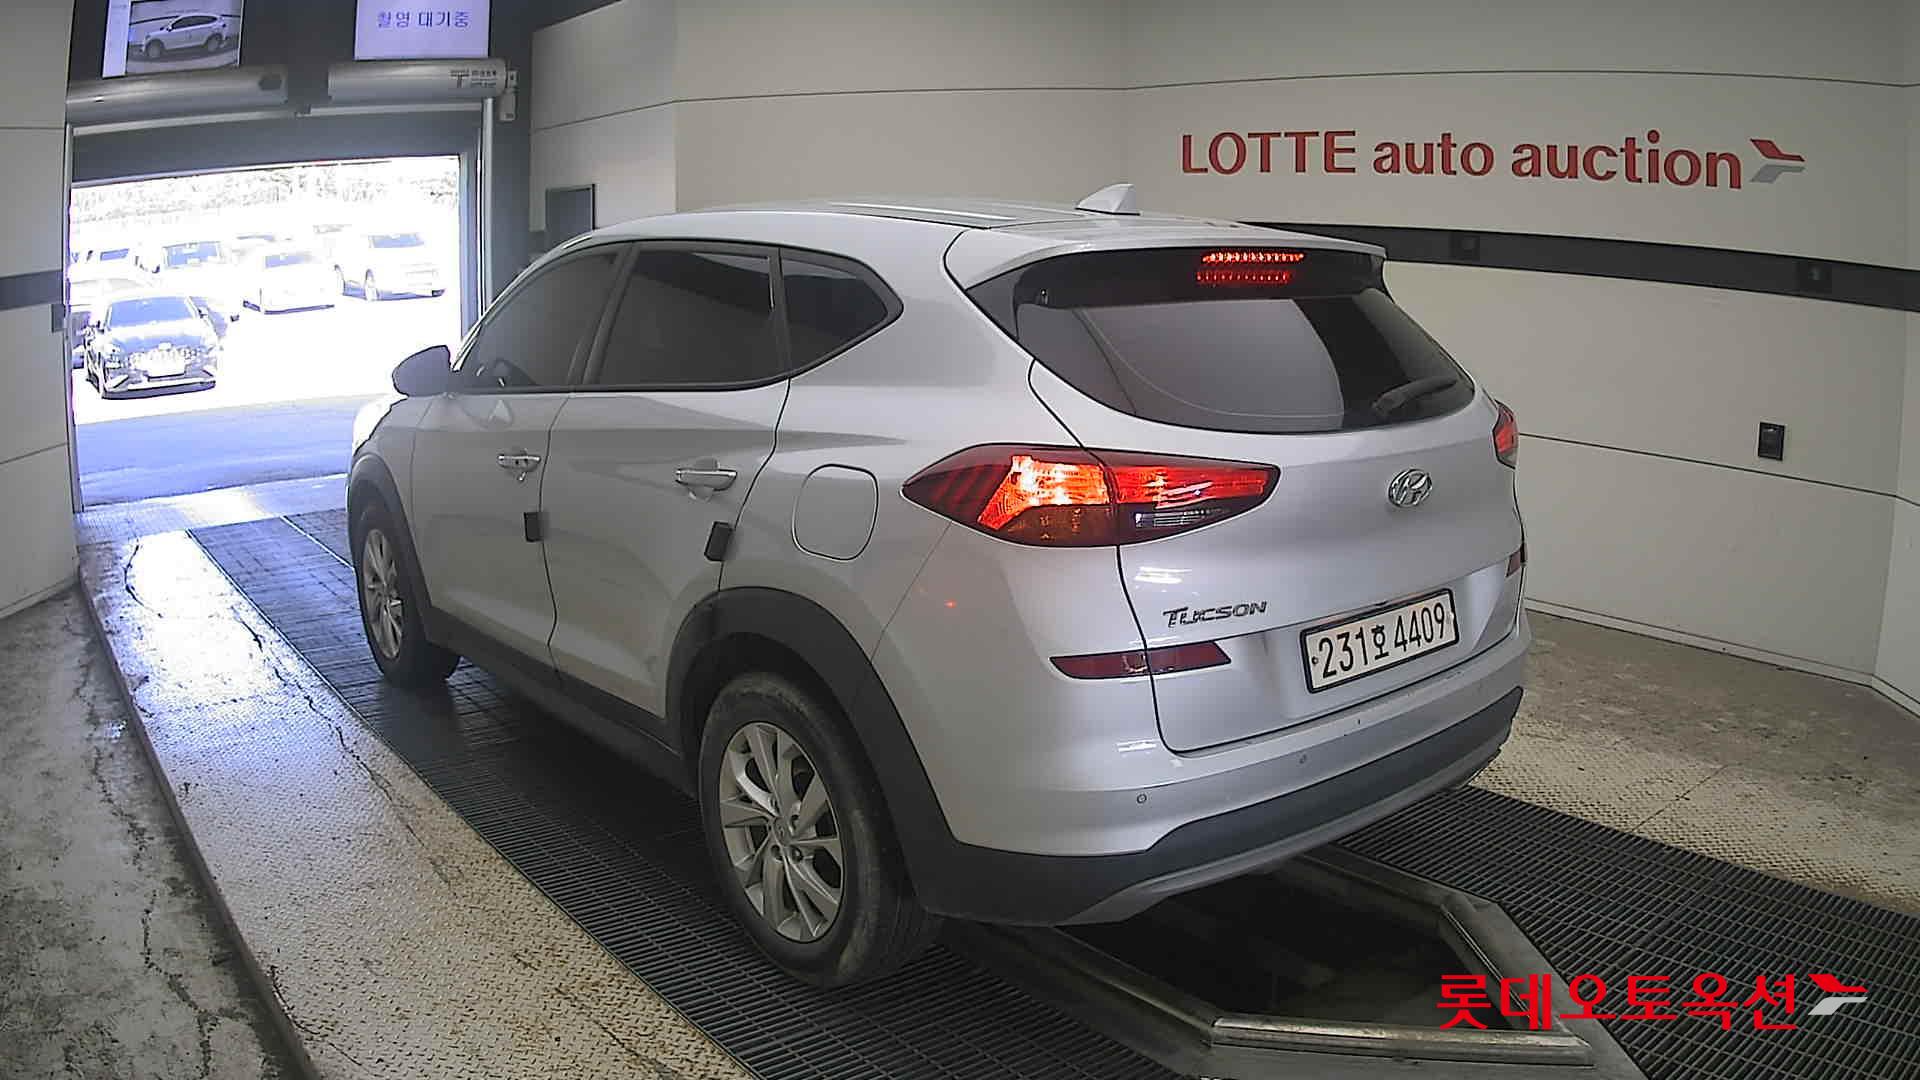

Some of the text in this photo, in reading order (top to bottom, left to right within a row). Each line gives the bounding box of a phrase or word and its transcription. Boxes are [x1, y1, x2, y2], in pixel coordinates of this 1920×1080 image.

[418, 10, 469, 28] 대기중
[1182, 130, 1742, 189] LOTTE auto auction
[1162, 601, 1268, 628] TUCSON
